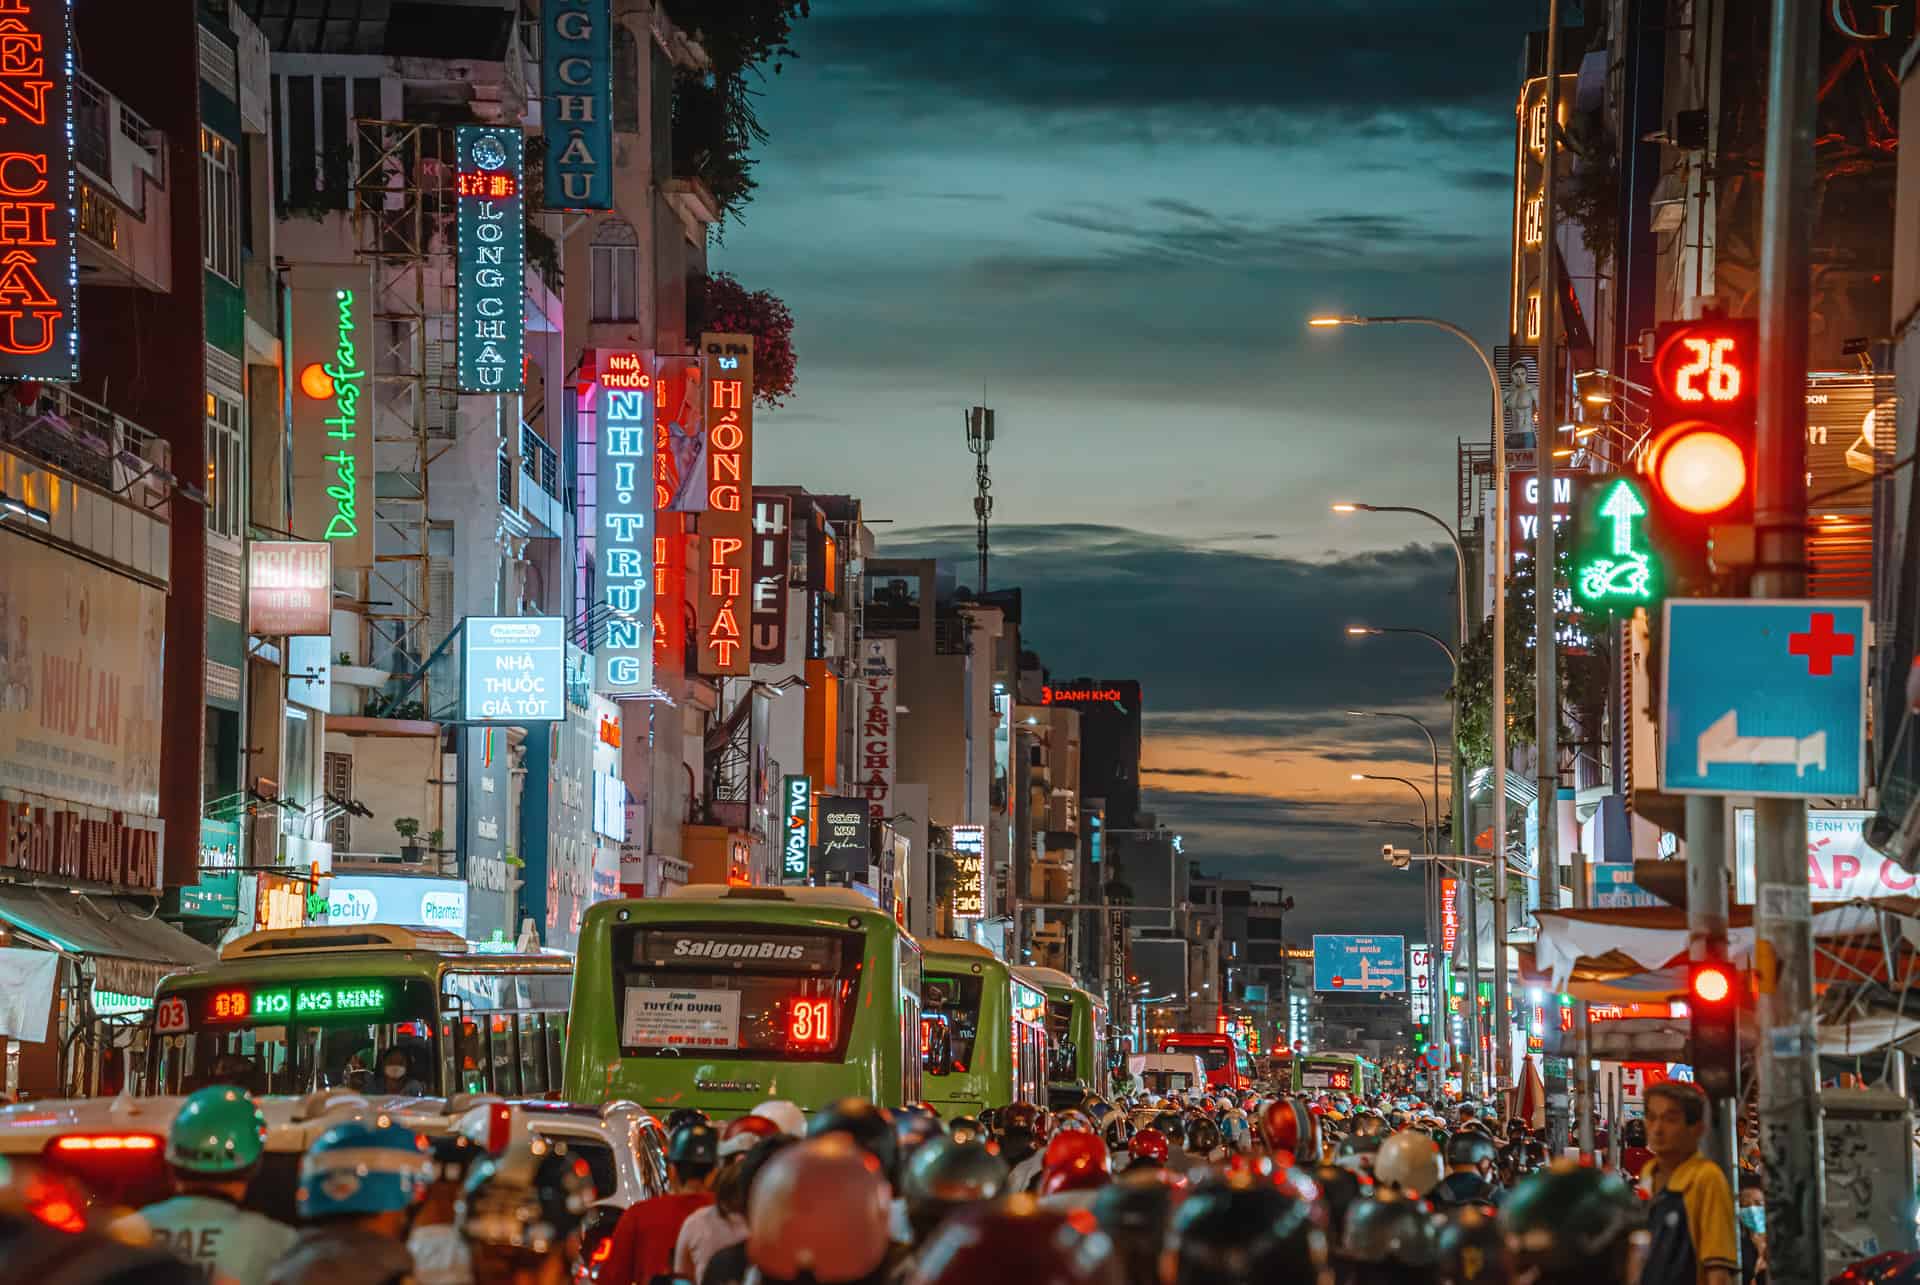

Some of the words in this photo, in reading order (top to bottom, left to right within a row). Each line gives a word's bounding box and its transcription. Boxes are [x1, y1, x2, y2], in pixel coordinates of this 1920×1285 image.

[559, 58, 596, 200] CHÂU
[475, 201, 505, 289] LONG
[474, 298, 506, 386] CHÂU
[323, 289, 365, 441] Hasfarm
[609, 354, 640, 371] NHÀ
[1676, 337, 1741, 402] 26
[601, 368, 650, 388] THUỐC
[324, 450, 357, 540] Dalat
[1525, 478, 1570, 504] GM
[605, 513, 647, 686] TRƯNG
[708, 538, 742, 667] PHÁT
[496, 653, 535, 671] NHÀ
[484, 673, 545, 693] THUỐC
[1055, 690, 1090, 700] DANH
[482, 697, 512, 715] GIÁ
[516, 697, 549, 715] TỐT
[674, 939, 804, 959] SaigonBus
[159, 1003, 184, 1029] 03
[792, 1001, 829, 1040] 31
[1334, 1074, 1347, 1088] 36
